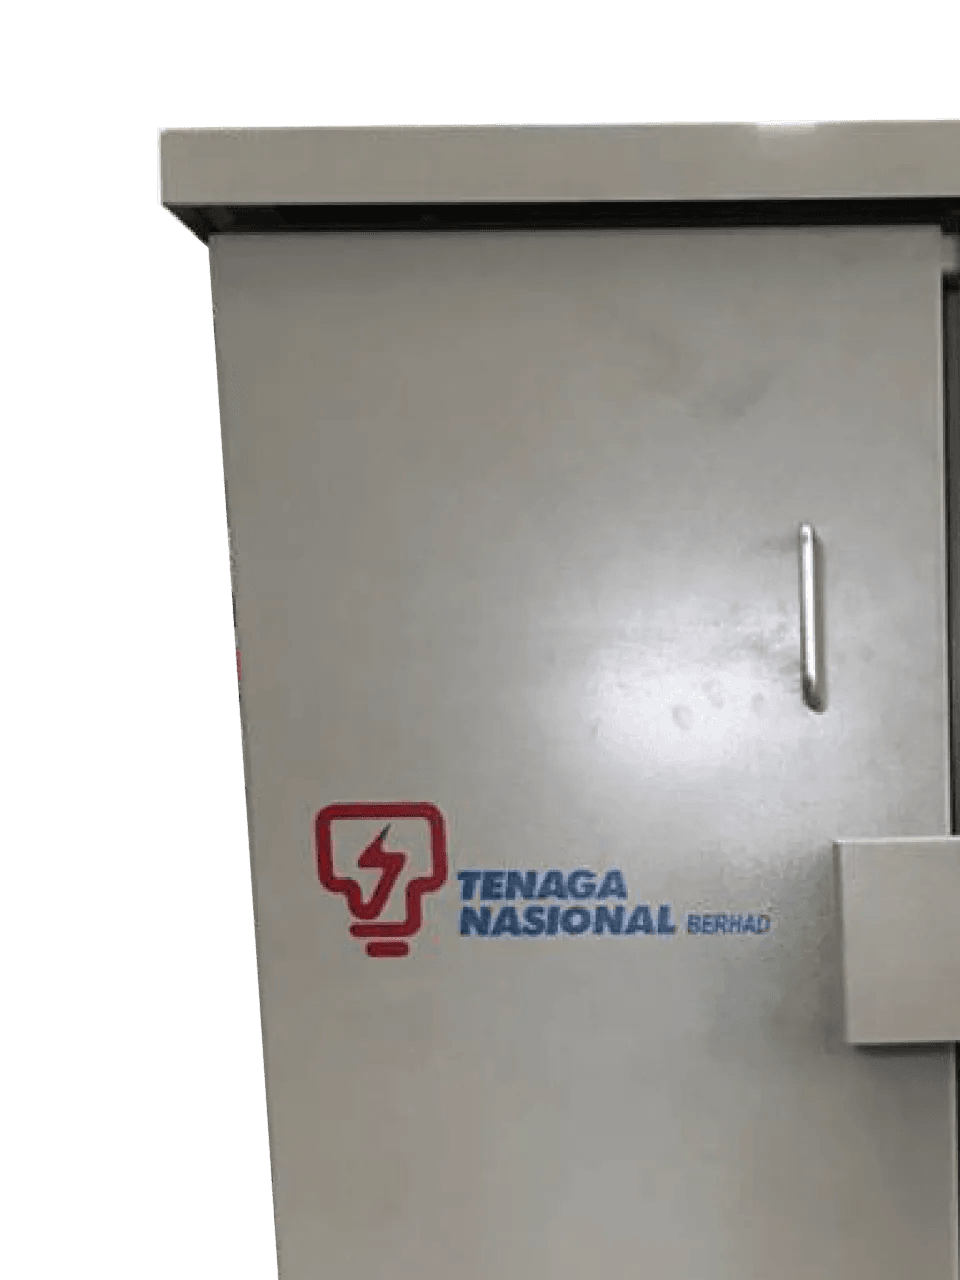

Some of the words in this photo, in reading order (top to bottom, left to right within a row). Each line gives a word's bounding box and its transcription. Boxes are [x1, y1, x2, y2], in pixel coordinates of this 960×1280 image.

[457, 870, 628, 901] TENAGA
[459, 905, 676, 936] NASIONAL
[687, 914, 771, 935] BERHAD
